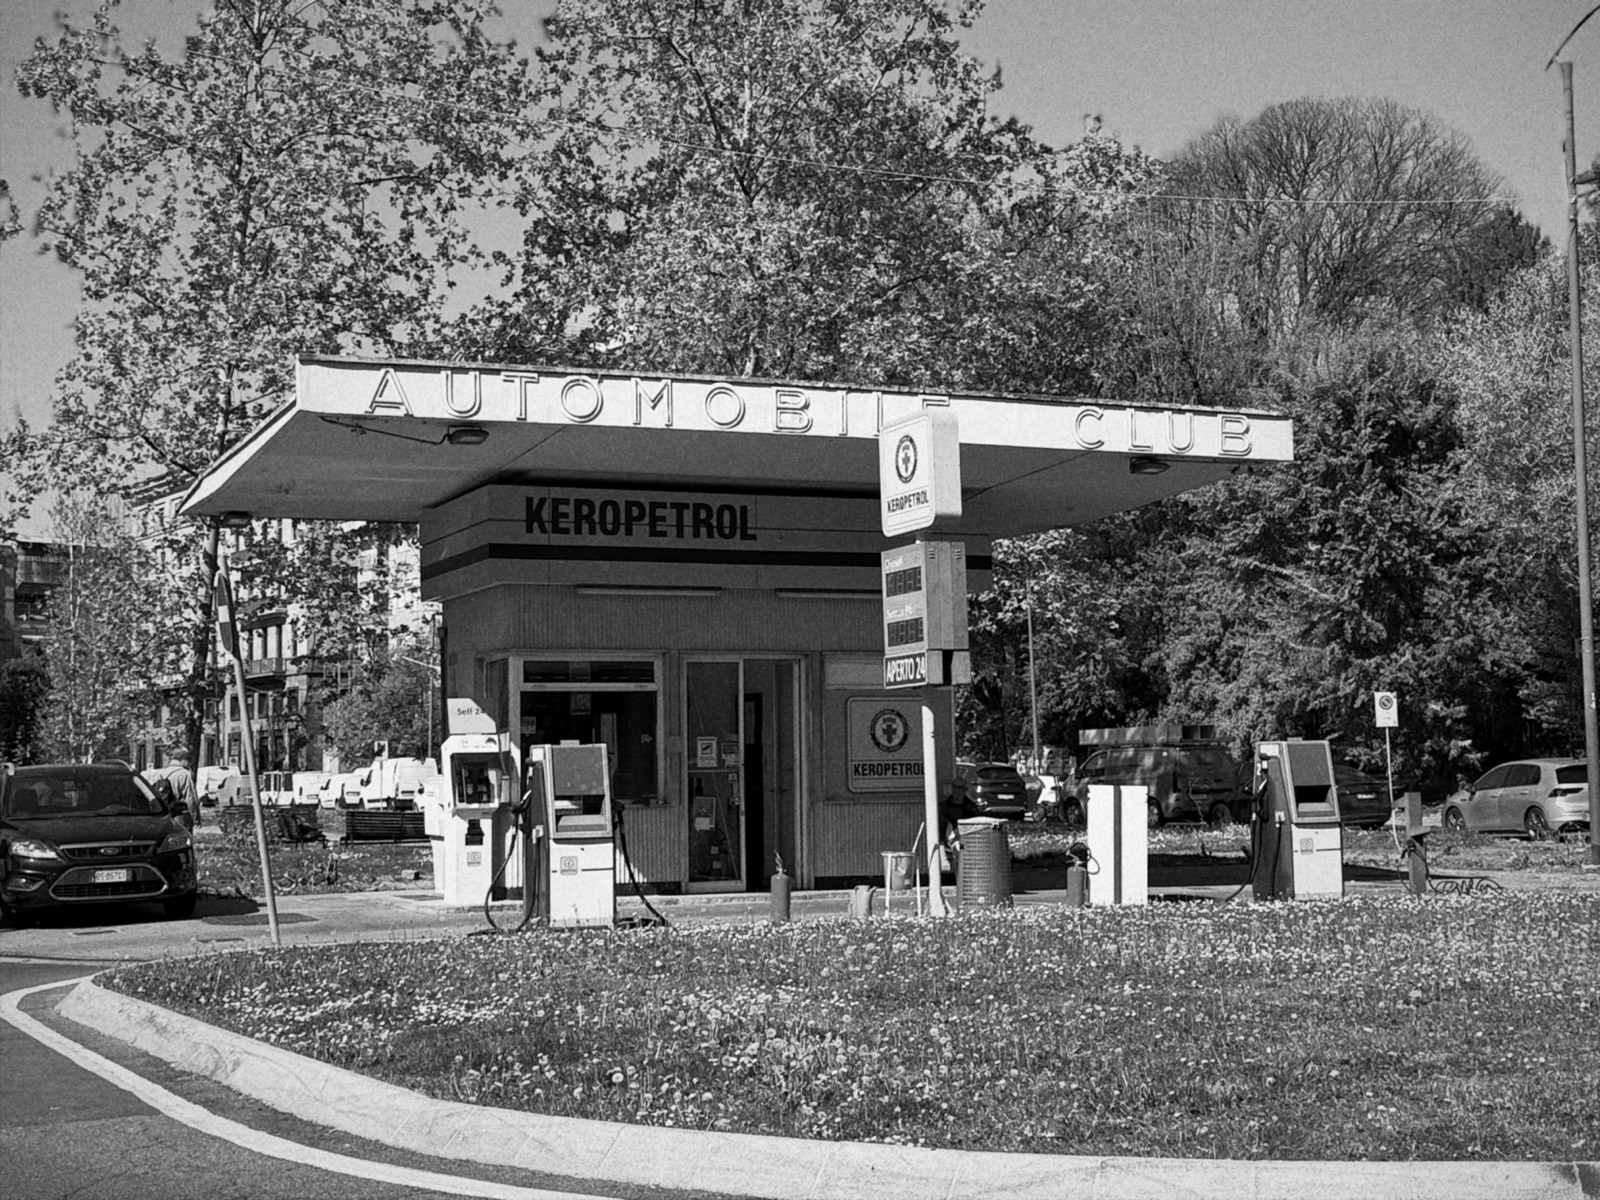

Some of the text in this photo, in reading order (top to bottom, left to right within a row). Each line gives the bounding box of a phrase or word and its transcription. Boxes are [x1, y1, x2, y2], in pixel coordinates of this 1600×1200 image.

[1073, 406, 1253, 457] CLUB
[887, 490, 930, 513] KEROPETROL
[525, 496, 757, 541] KEROPETROL
[886, 656, 926, 682] APERTO 24
[457, 707, 473, 716] Self
